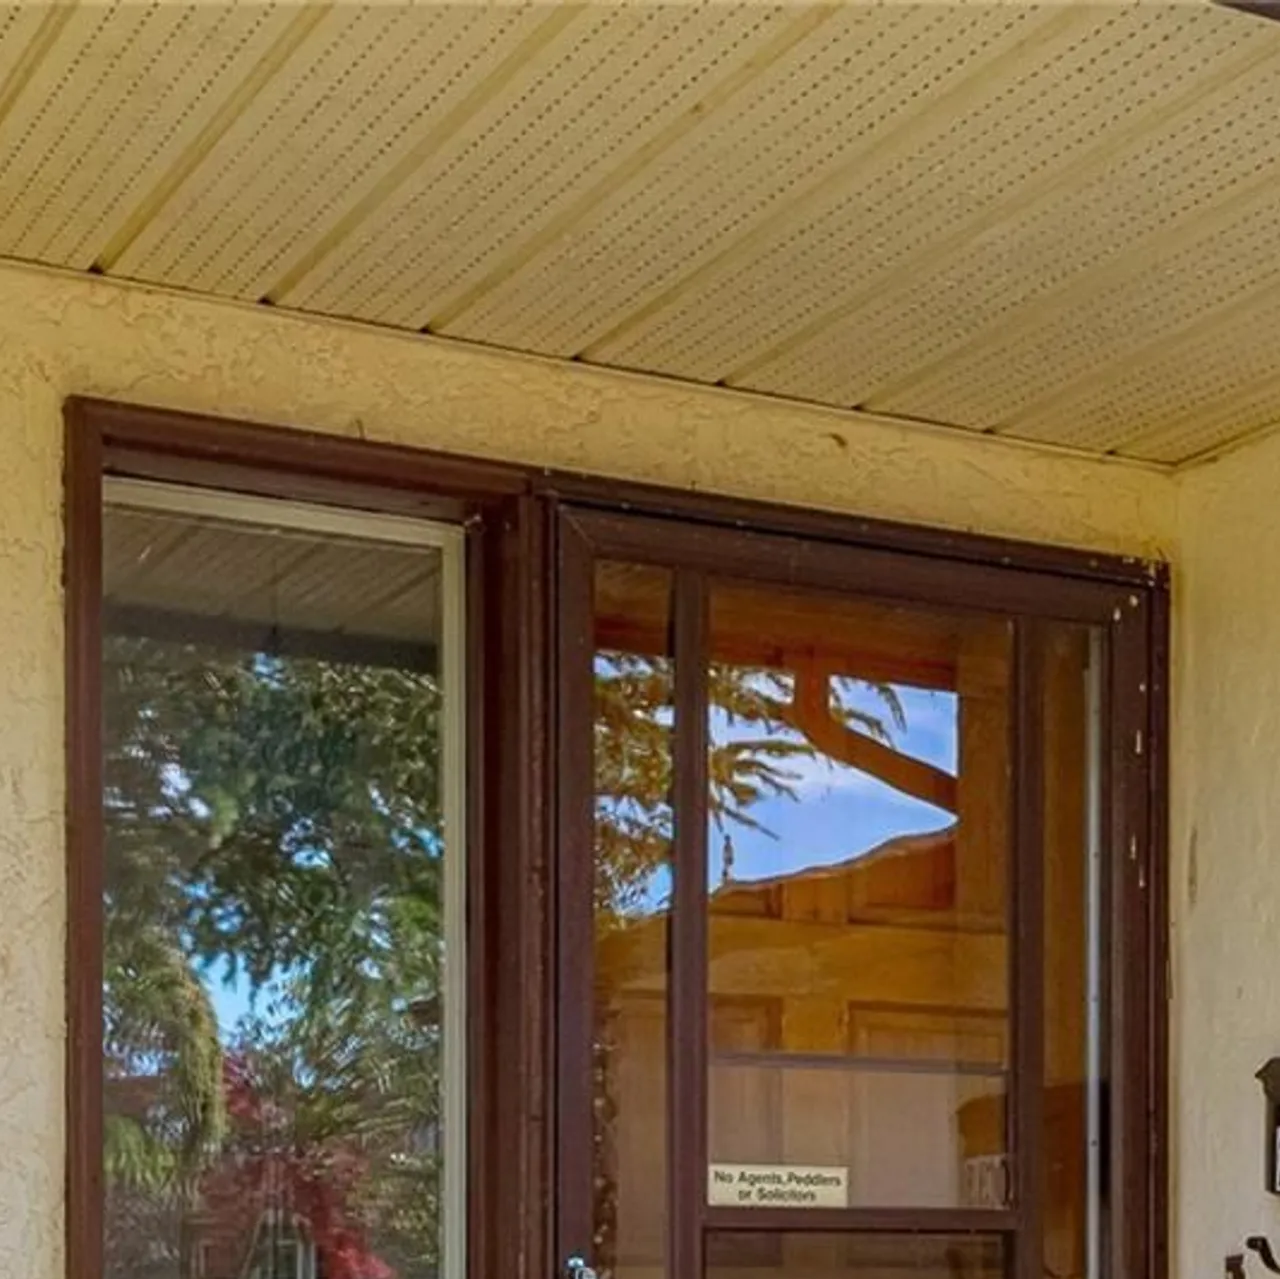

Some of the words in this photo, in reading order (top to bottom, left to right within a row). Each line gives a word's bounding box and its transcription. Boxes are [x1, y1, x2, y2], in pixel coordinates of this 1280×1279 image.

[713, 1171, 734, 1184] No
[738, 1189, 752, 1201] or
[757, 1187, 817, 1202] Solicitors
